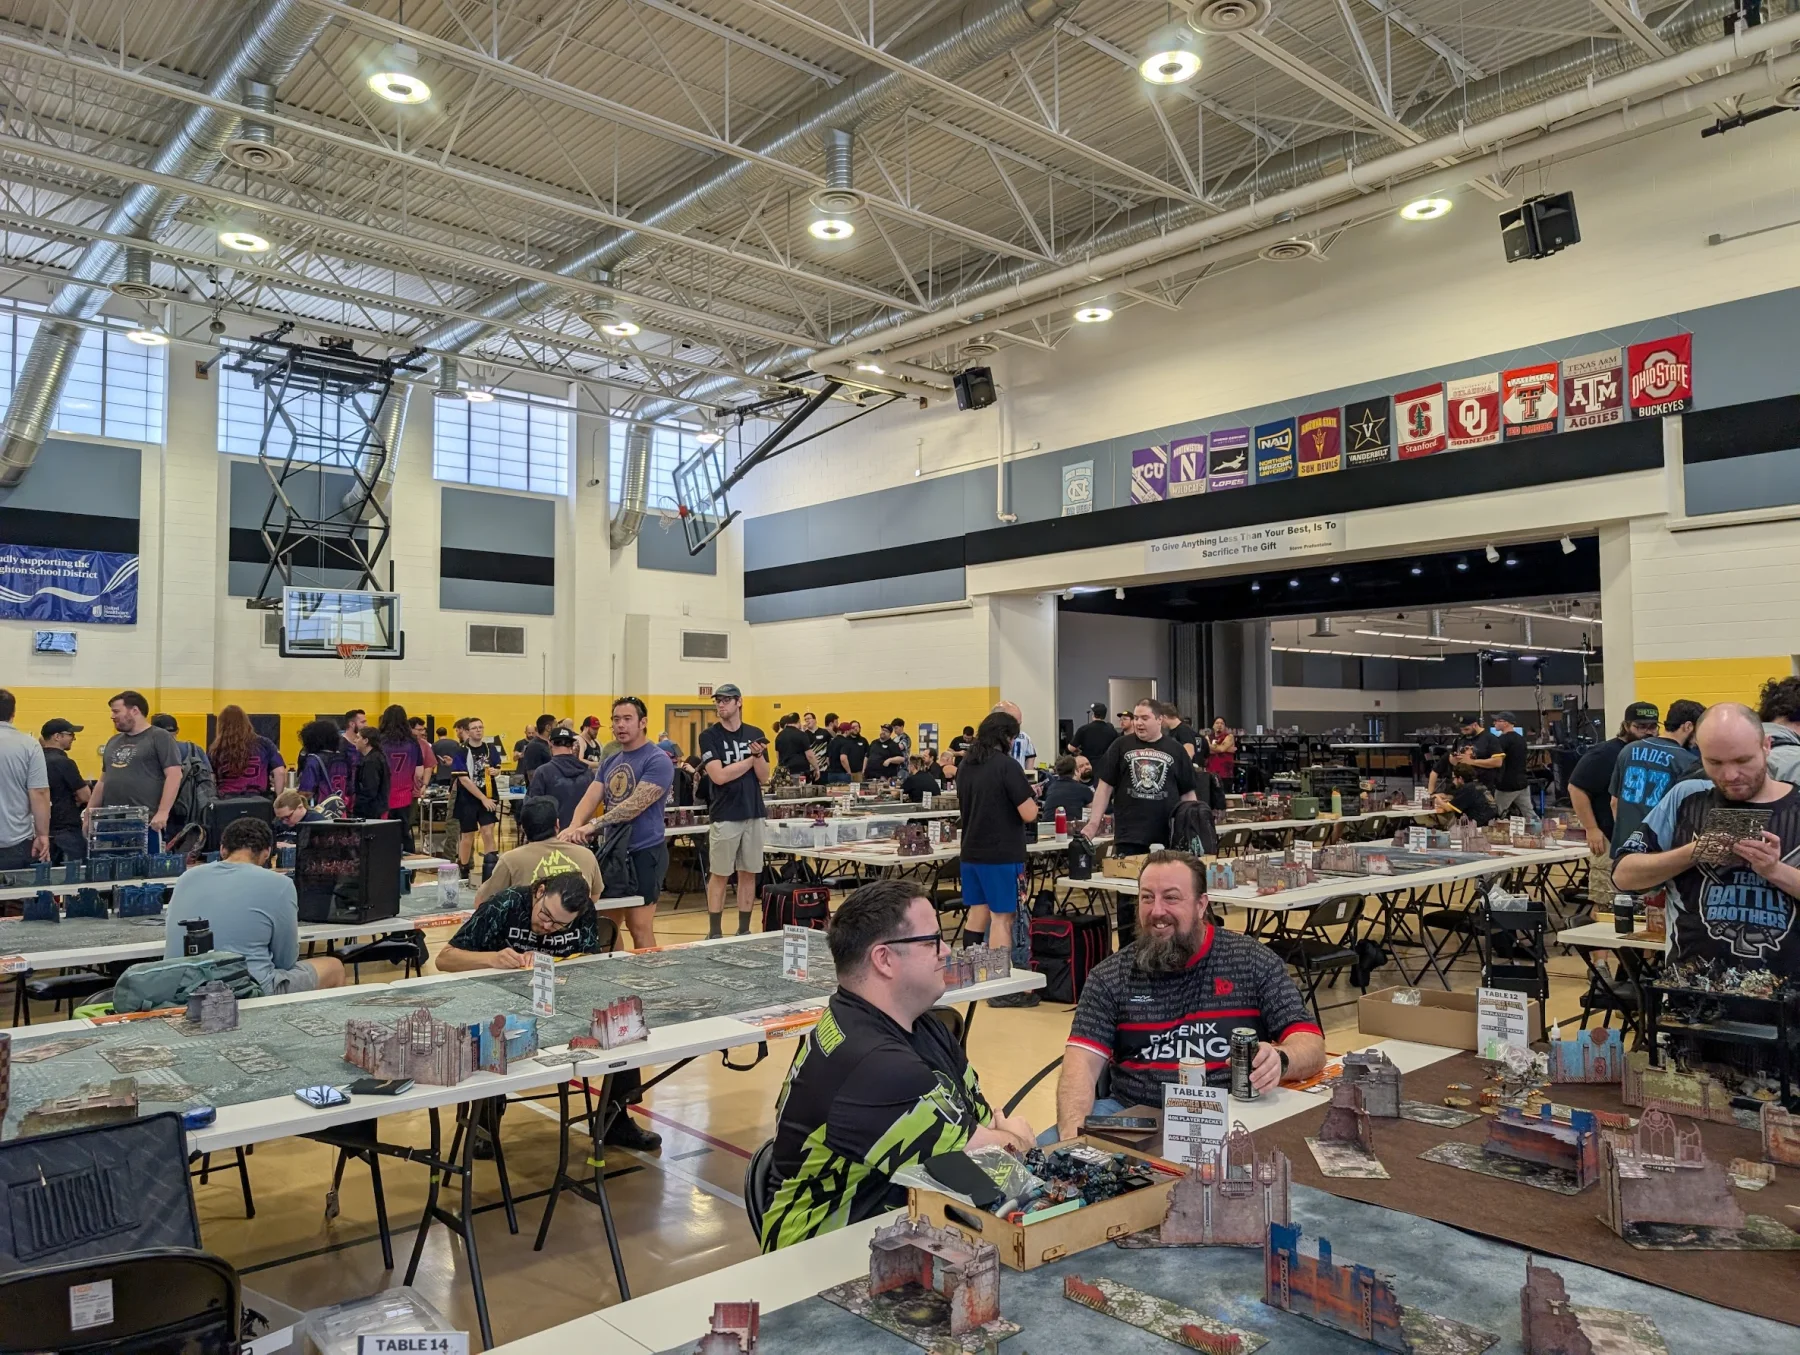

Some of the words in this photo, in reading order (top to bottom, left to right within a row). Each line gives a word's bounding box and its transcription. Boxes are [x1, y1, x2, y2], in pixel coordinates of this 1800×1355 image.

[1568, 361, 1596, 372] TEXAS
[1598, 356, 1617, 367] A&M
[1639, 399, 1684, 417] BUCKEYES
[1459, 399, 1487, 436] OU
[1569, 411, 1619, 428] AGGIES
[1363, 423, 1374, 438] V
[1261, 435, 1289, 450] NAU
[1405, 439, 1438, 453] Stanford
[1451, 434, 1496, 446] SOONERS
[1259, 455, 1292, 466] NORTHERN
[1349, 448, 1389, 462] VANDERBILT
[1133, 462, 1164, 479] TCU
[1181, 453, 1196, 482] N
[1172, 482, 1204, 494] WILDCATS
[1212, 479, 1244, 487] LOPES
[1150, 545, 1160, 553] To
[1162, 542, 1180, 551] Give
[1181, 537, 1217, 549] Anything
[1218, 535, 1239, 545] Less
[1265, 528, 1285, 538] Your
[1287, 524, 1311, 535] Best,
[1313, 522, 1323, 532] Is
[1325, 521, 1337, 530] To
[1202, 547, 1239, 558] Sacrifice
[1241, 544, 1258, 554] The
[1260, 541, 1277, 551] Gift
[20, 557, 73, 569] supporting
[74, 560, 90, 568] the
[29, 567, 61, 576] School
[63, 568, 98, 579] District
[391, 753, 407, 773] 7
[1632, 747, 1675, 767] HADES
[1622, 766, 1671, 807] 97
[1733, 872, 1767, 886] TEAM
[1707, 884, 1788, 914] BATTLE
[1707, 906, 1787, 930] BROTHERS
[1173, 1087, 1204, 1097] TABLE
[1205, 1090, 1216, 1099] 13
[1166, 1098, 1200, 1108] SCORCHED
[1201, 1100, 1224, 1114] EARTH
[376, 1339, 427, 1351] TABLE
[430, 1338, 448, 1350] 14
